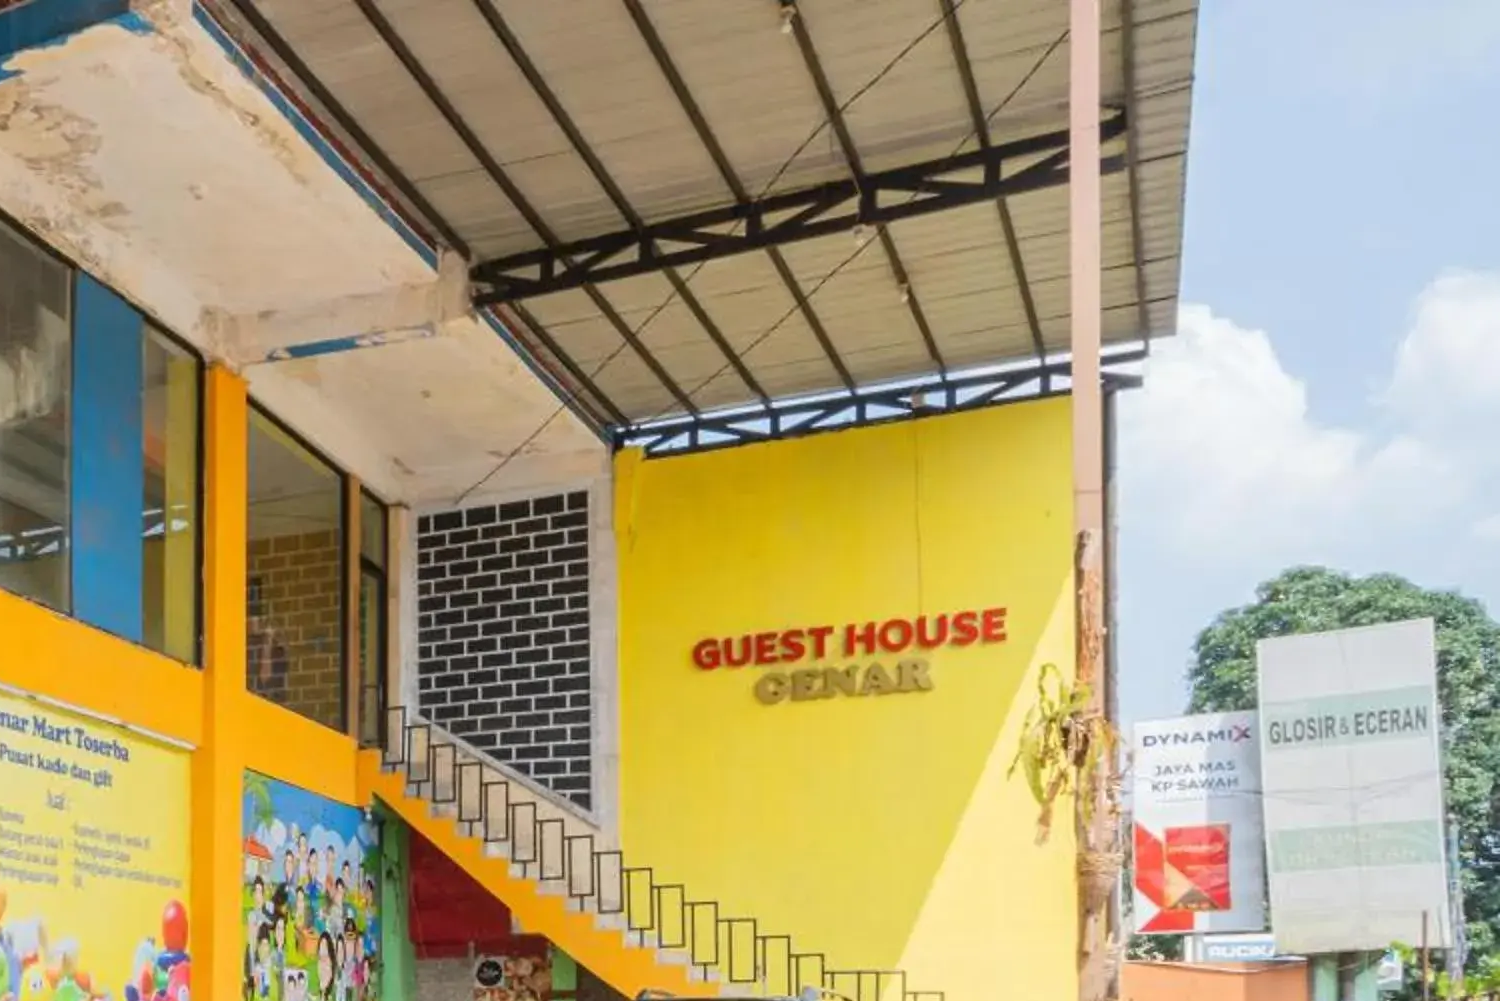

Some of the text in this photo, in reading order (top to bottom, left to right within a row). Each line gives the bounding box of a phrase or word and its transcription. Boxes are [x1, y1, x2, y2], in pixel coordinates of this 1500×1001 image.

[692, 607, 1007, 671] GUEST HOUSE
[31, 714, 72, 746] Mart
[74, 727, 130, 763] Toserba
[1142, 724, 1252, 748] DYNAMIX
[1269, 705, 1428, 745] GLOSIR & ECERAN
[36, 751, 69, 775] kado
[70, 761, 92, 782] dan
[1155, 760, 1237, 777] JAYA MAS
